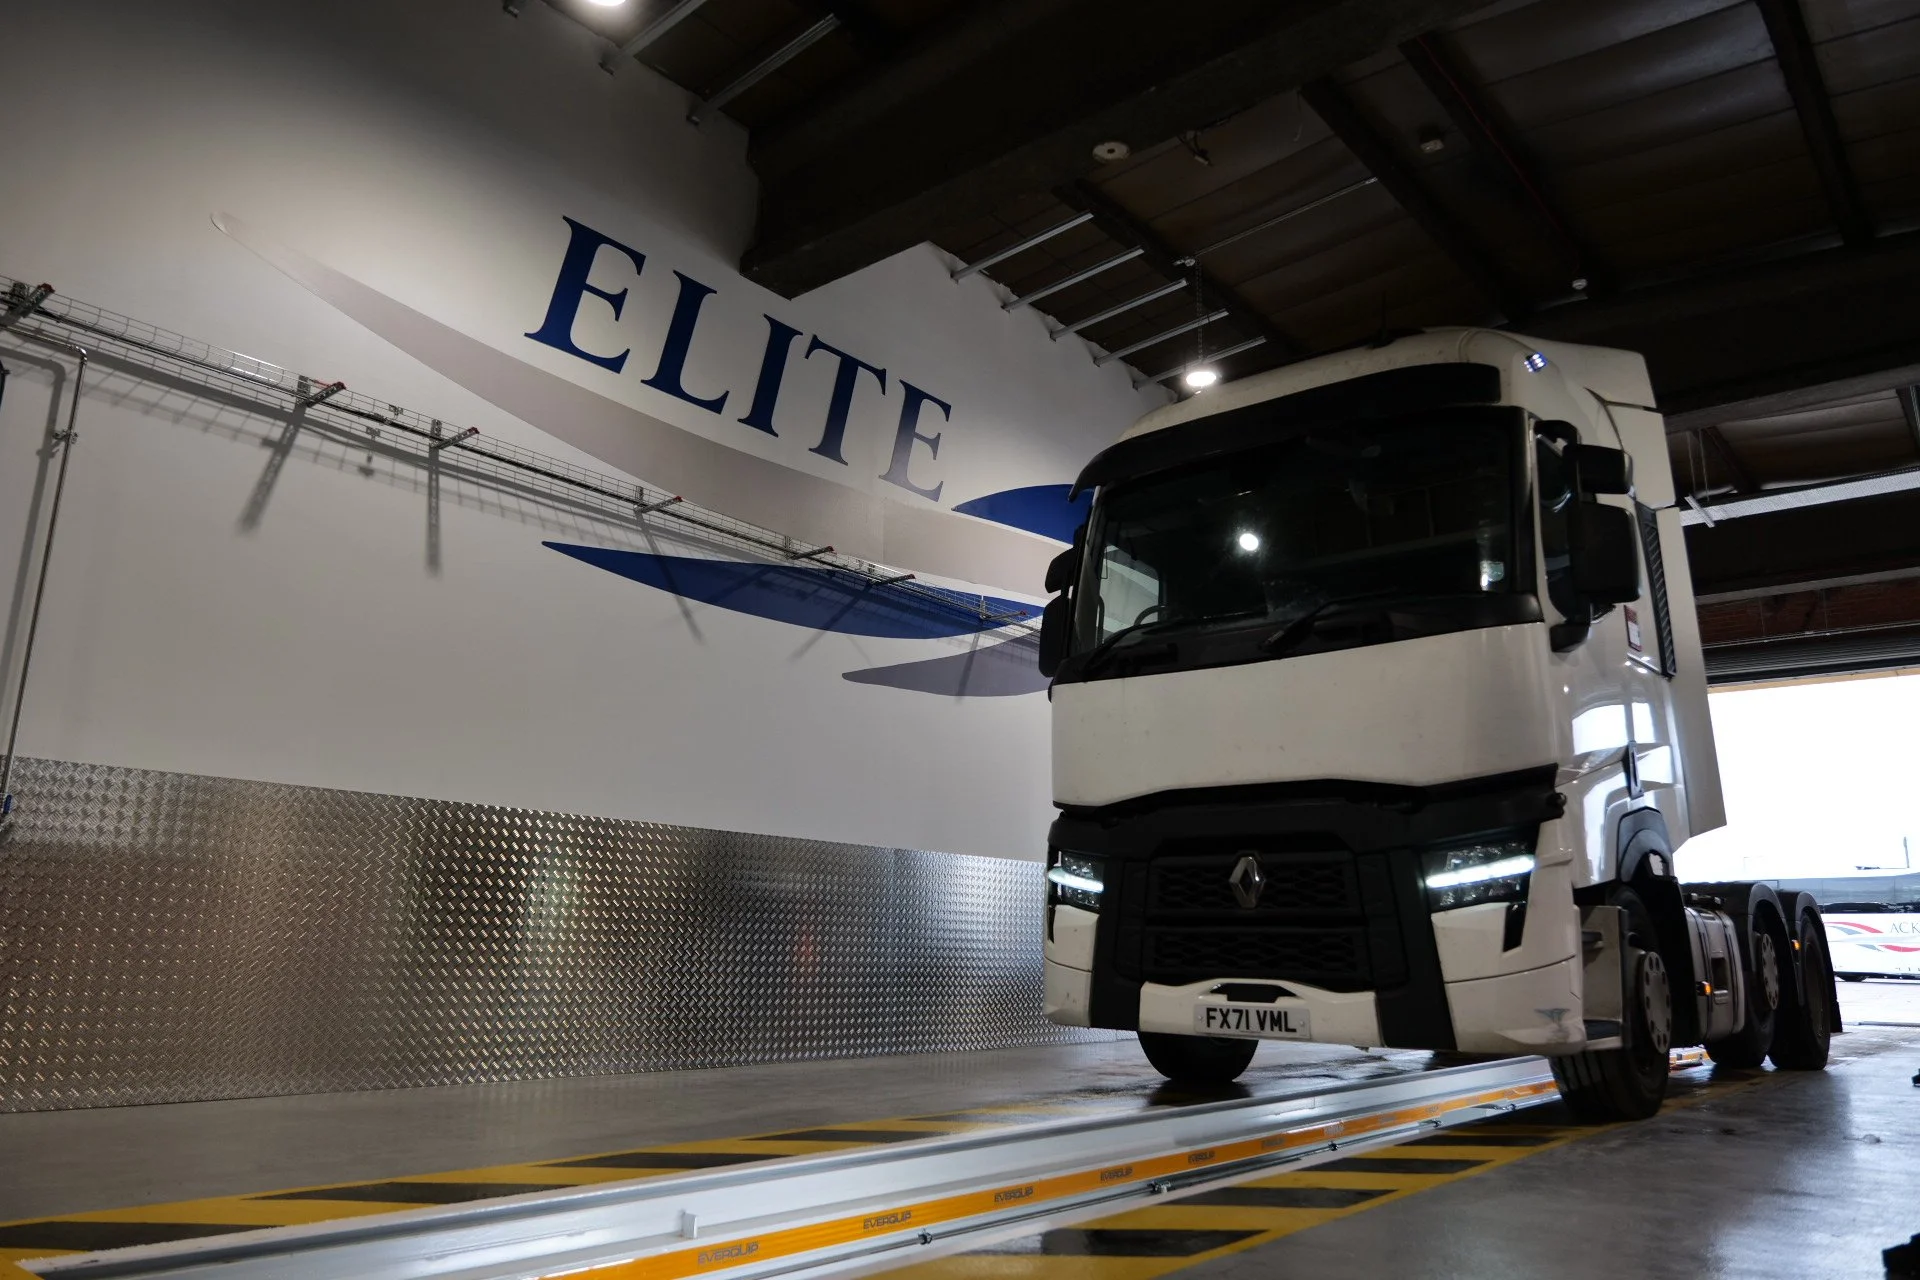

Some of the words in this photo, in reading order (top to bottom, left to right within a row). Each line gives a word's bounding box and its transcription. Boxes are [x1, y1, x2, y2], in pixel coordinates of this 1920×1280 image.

[524, 215, 952, 503] ELITE
[1206, 1007, 1250, 1031] FX71
[1256, 1009, 1297, 1033] VML
[994, 1186, 1033, 1203] EVERQUIP
[864, 1211, 912, 1230] EVERQUIP
[698, 1243, 759, 1265] EVERQUIP
